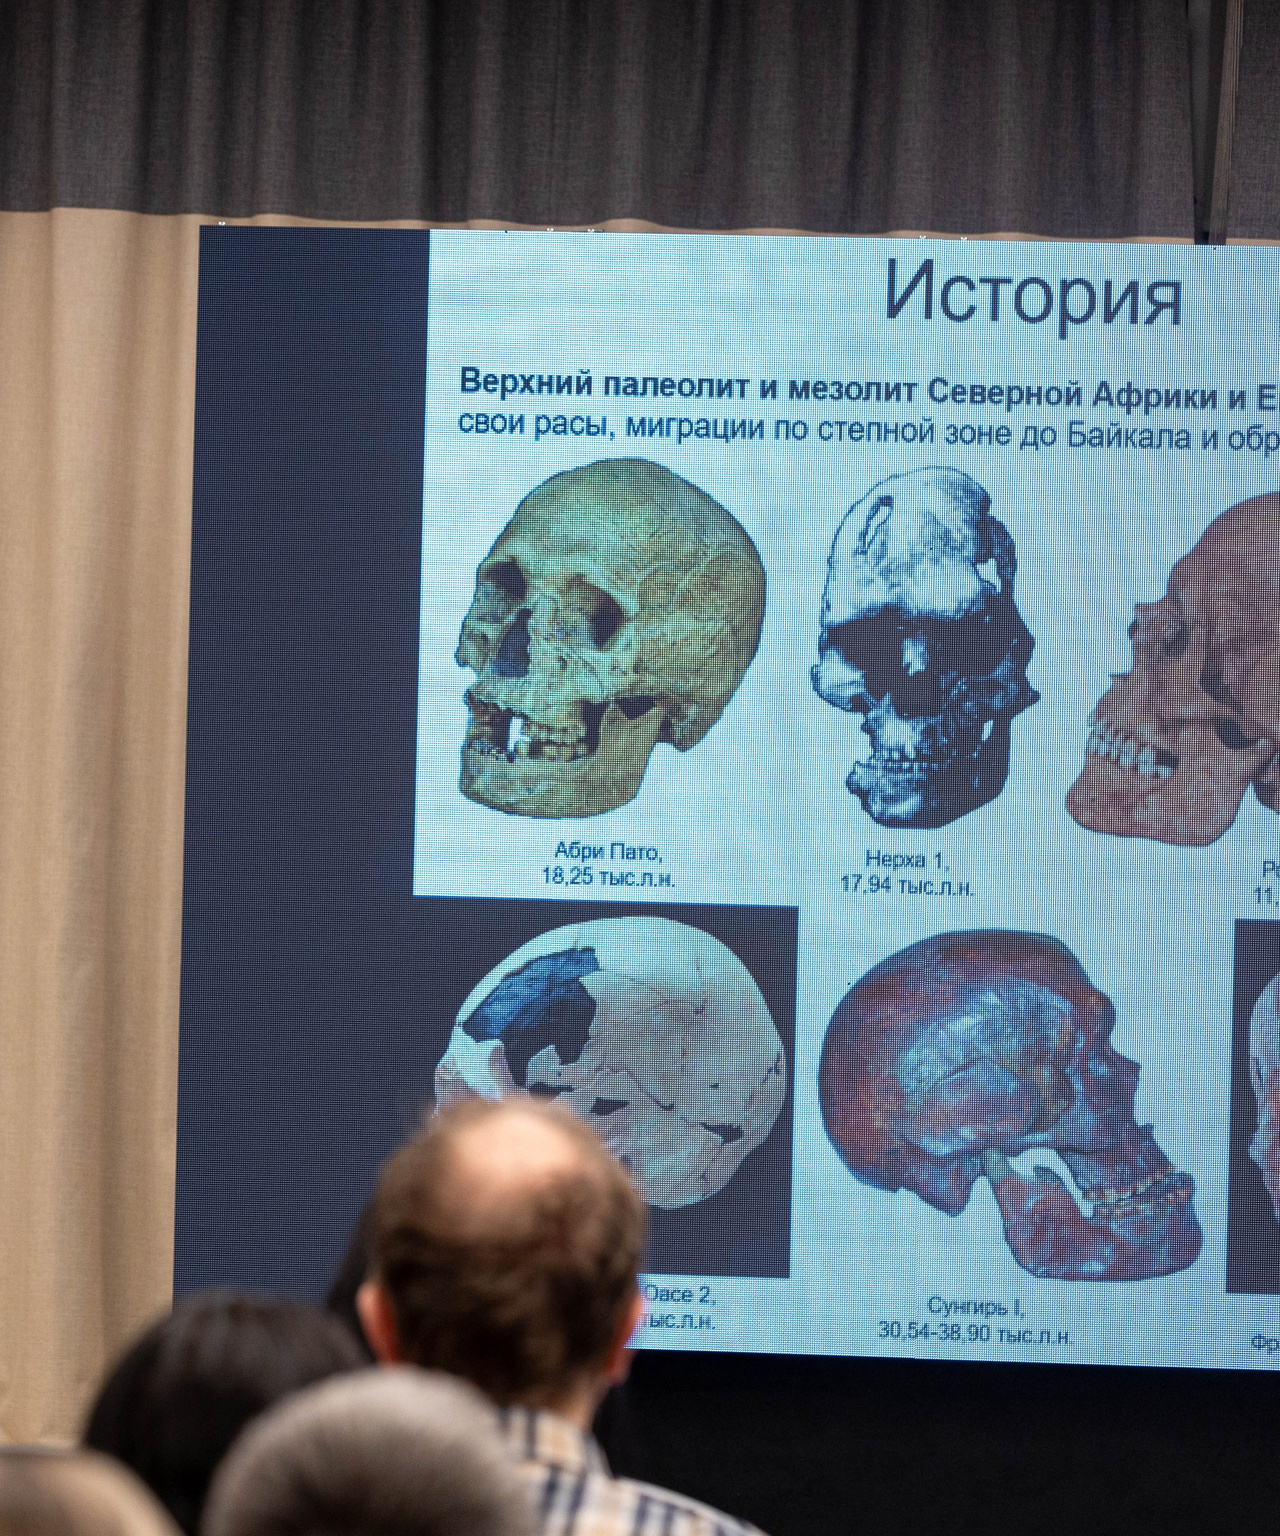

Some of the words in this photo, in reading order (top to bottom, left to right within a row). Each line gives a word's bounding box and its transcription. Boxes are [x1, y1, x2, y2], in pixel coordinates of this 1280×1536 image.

[887, 257, 1182, 341] История
[460, 366, 593, 400] Верхний
[604, 376, 750, 398] палеолит
[760, 380, 777, 398] и
[789, 380, 919, 401] мезолит
[929, 376, 1083, 412] Северной
[1093, 380, 1218, 415] Африки
[1229, 390, 1246, 409] и
[1258, 384, 1280, 411] Е
[459, 413, 525, 434] свои
[534, 414, 615, 441] расы,
[627, 416, 764, 444] миграции
[774, 420, 808, 441] по
[819, 417, 935, 443] степной
[945, 424, 1012, 445] зоне
[1020, 425, 1057, 450] до
[1069, 420, 1191, 449] Байкала
[1203, 430, 1218, 449] и
[554, 841, 604, 862] Абри
[610, 842, 663, 863] Пато,
[865, 849, 926, 871] Нерха
[935, 851, 950, 871] 1,
[543, 866, 593, 887] 18,25
[599, 871, 675, 887] тыс.л.н.
[841, 873, 891, 894] 17,94
[898, 879, 975, 897] тыс.л.н.
[699, 1285, 716, 1305] 2,
[928, 1296, 1008, 1319] Сунгирь
[878, 1320, 990, 1343] 30,54-38,90
[998, 1328, 1073, 1344] тыс.л.н.
